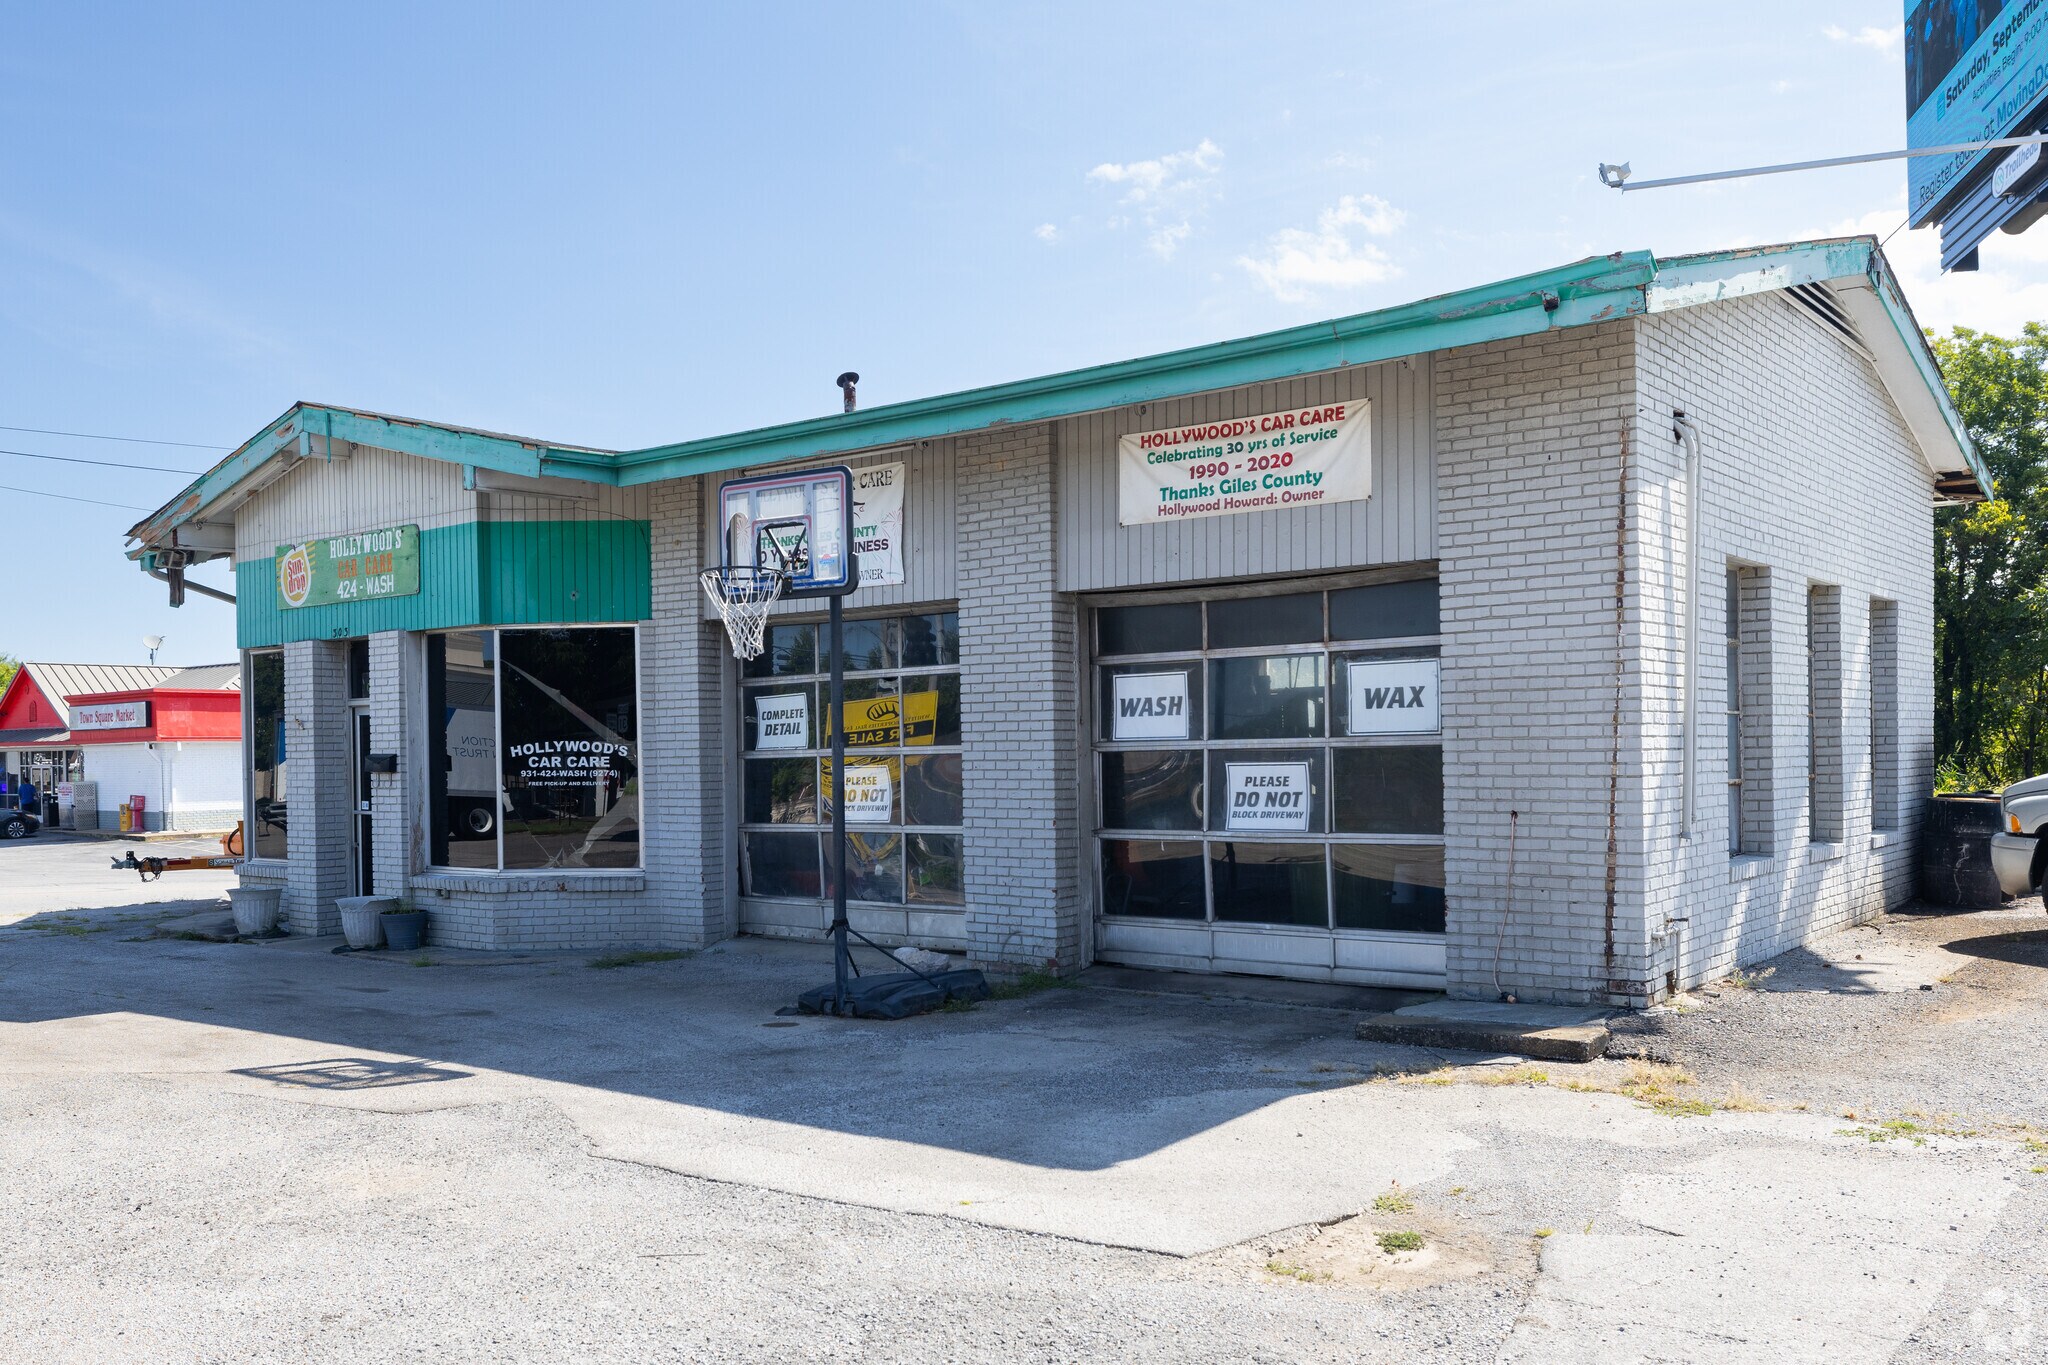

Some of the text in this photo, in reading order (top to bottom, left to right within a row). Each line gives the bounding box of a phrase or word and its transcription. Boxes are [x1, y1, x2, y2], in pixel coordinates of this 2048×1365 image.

[1946, 0, 2044, 108] Saturday, Septemb
[1972, 66, 2000, 104] Activities
[1920, 160, 1953, 204] Register
[1984, 117, 1994, 141] at
[1140, 405, 1345, 449] HOLLYWOOD'S CAR CARE
[1147, 428, 1338, 465] Celebrating 30 yrs of Service
[1189, 461, 1229, 480] 1990
[1247, 452, 1294, 472] 2020
[859, 469, 893, 489] CARE
[1160, 470, 1323, 502] Thanks Giles County
[1158, 490, 1325, 517] Hollywood Howard: Owner
[329, 528, 402, 559] HOLLYWOOD'S
[761, 533, 800, 549] THNKS
[337, 553, 393, 579] CAR CARE
[337, 579, 357, 599] 424
[366, 574, 394, 595] WASH
[1120, 695, 1183, 718] WASH
[1364, 685, 1425, 710] WAX
[79, 708, 135, 726] Town Square Market
[761, 708, 804, 721] COMPLETE
[764, 722, 801, 737] DETAIL
[510, 740, 628, 757] HOLLYWOOD'S
[528, 756, 610, 768] CAR CARE
[520, 769, 618, 778] 931-424-WASH (9274)
[845, 776, 877, 786] PLEASE
[1244, 776, 1290, 787] PLEASE
[861, 788, 887, 803] NOT
[1233, 791, 1304, 808] DO NOT
[857, 804, 889, 812] DRIVEWAY
[1232, 810, 1305, 819] BLOCK DRIVEWAY
